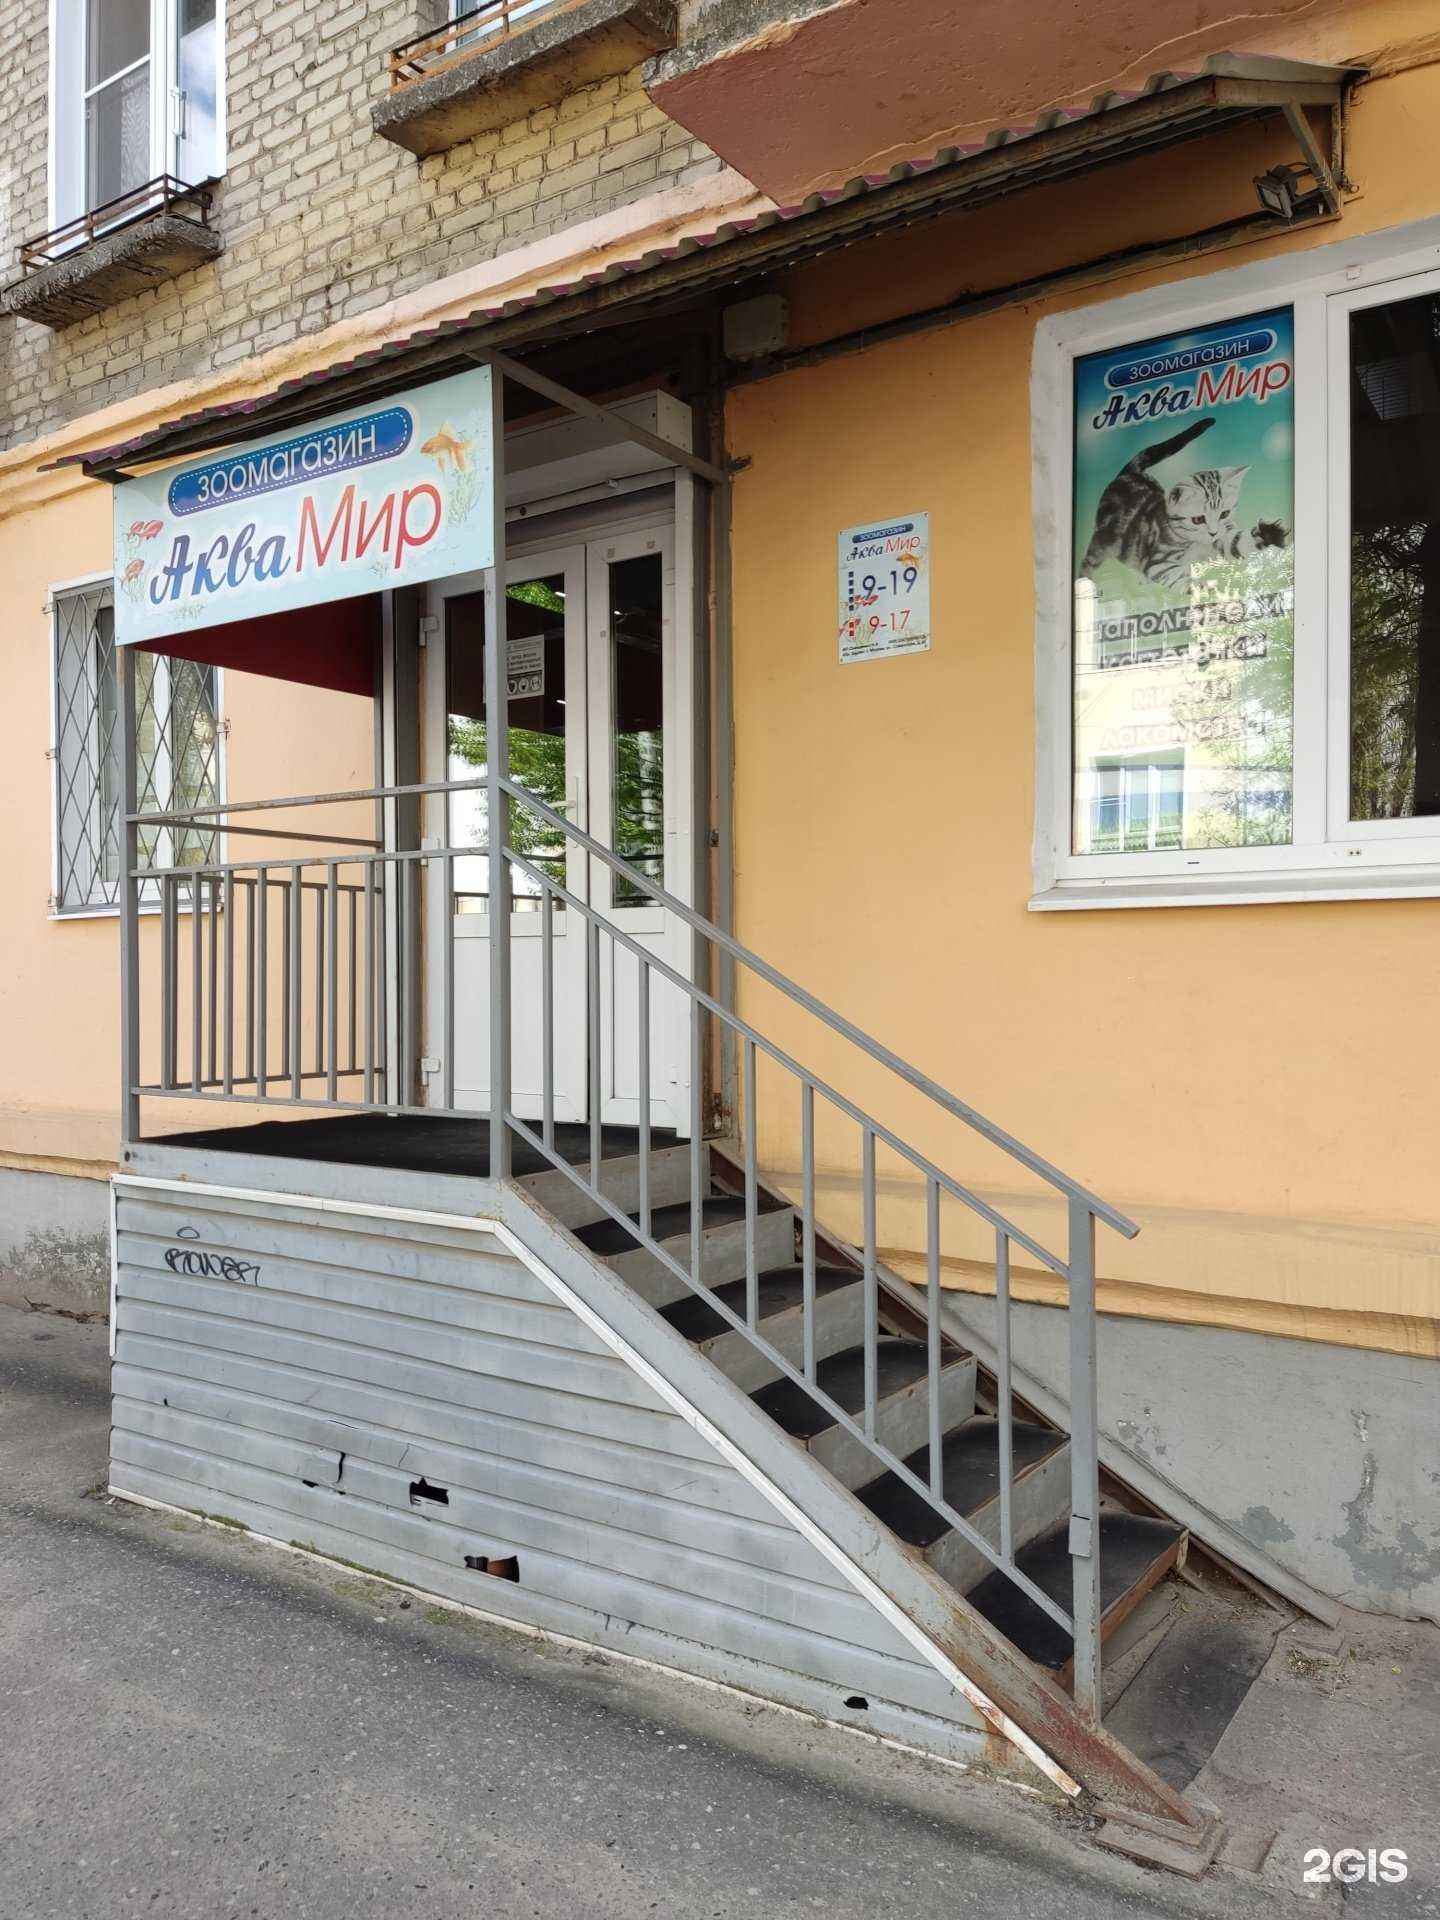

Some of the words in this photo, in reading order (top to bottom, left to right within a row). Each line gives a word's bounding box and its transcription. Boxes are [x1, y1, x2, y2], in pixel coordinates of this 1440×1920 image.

[1128, 336, 1250, 382] зоомагазин
[197, 424, 377, 502] зоомагазин
[862, 566, 918, 601] 9-19
[869, 609, 911, 634] 9-17
